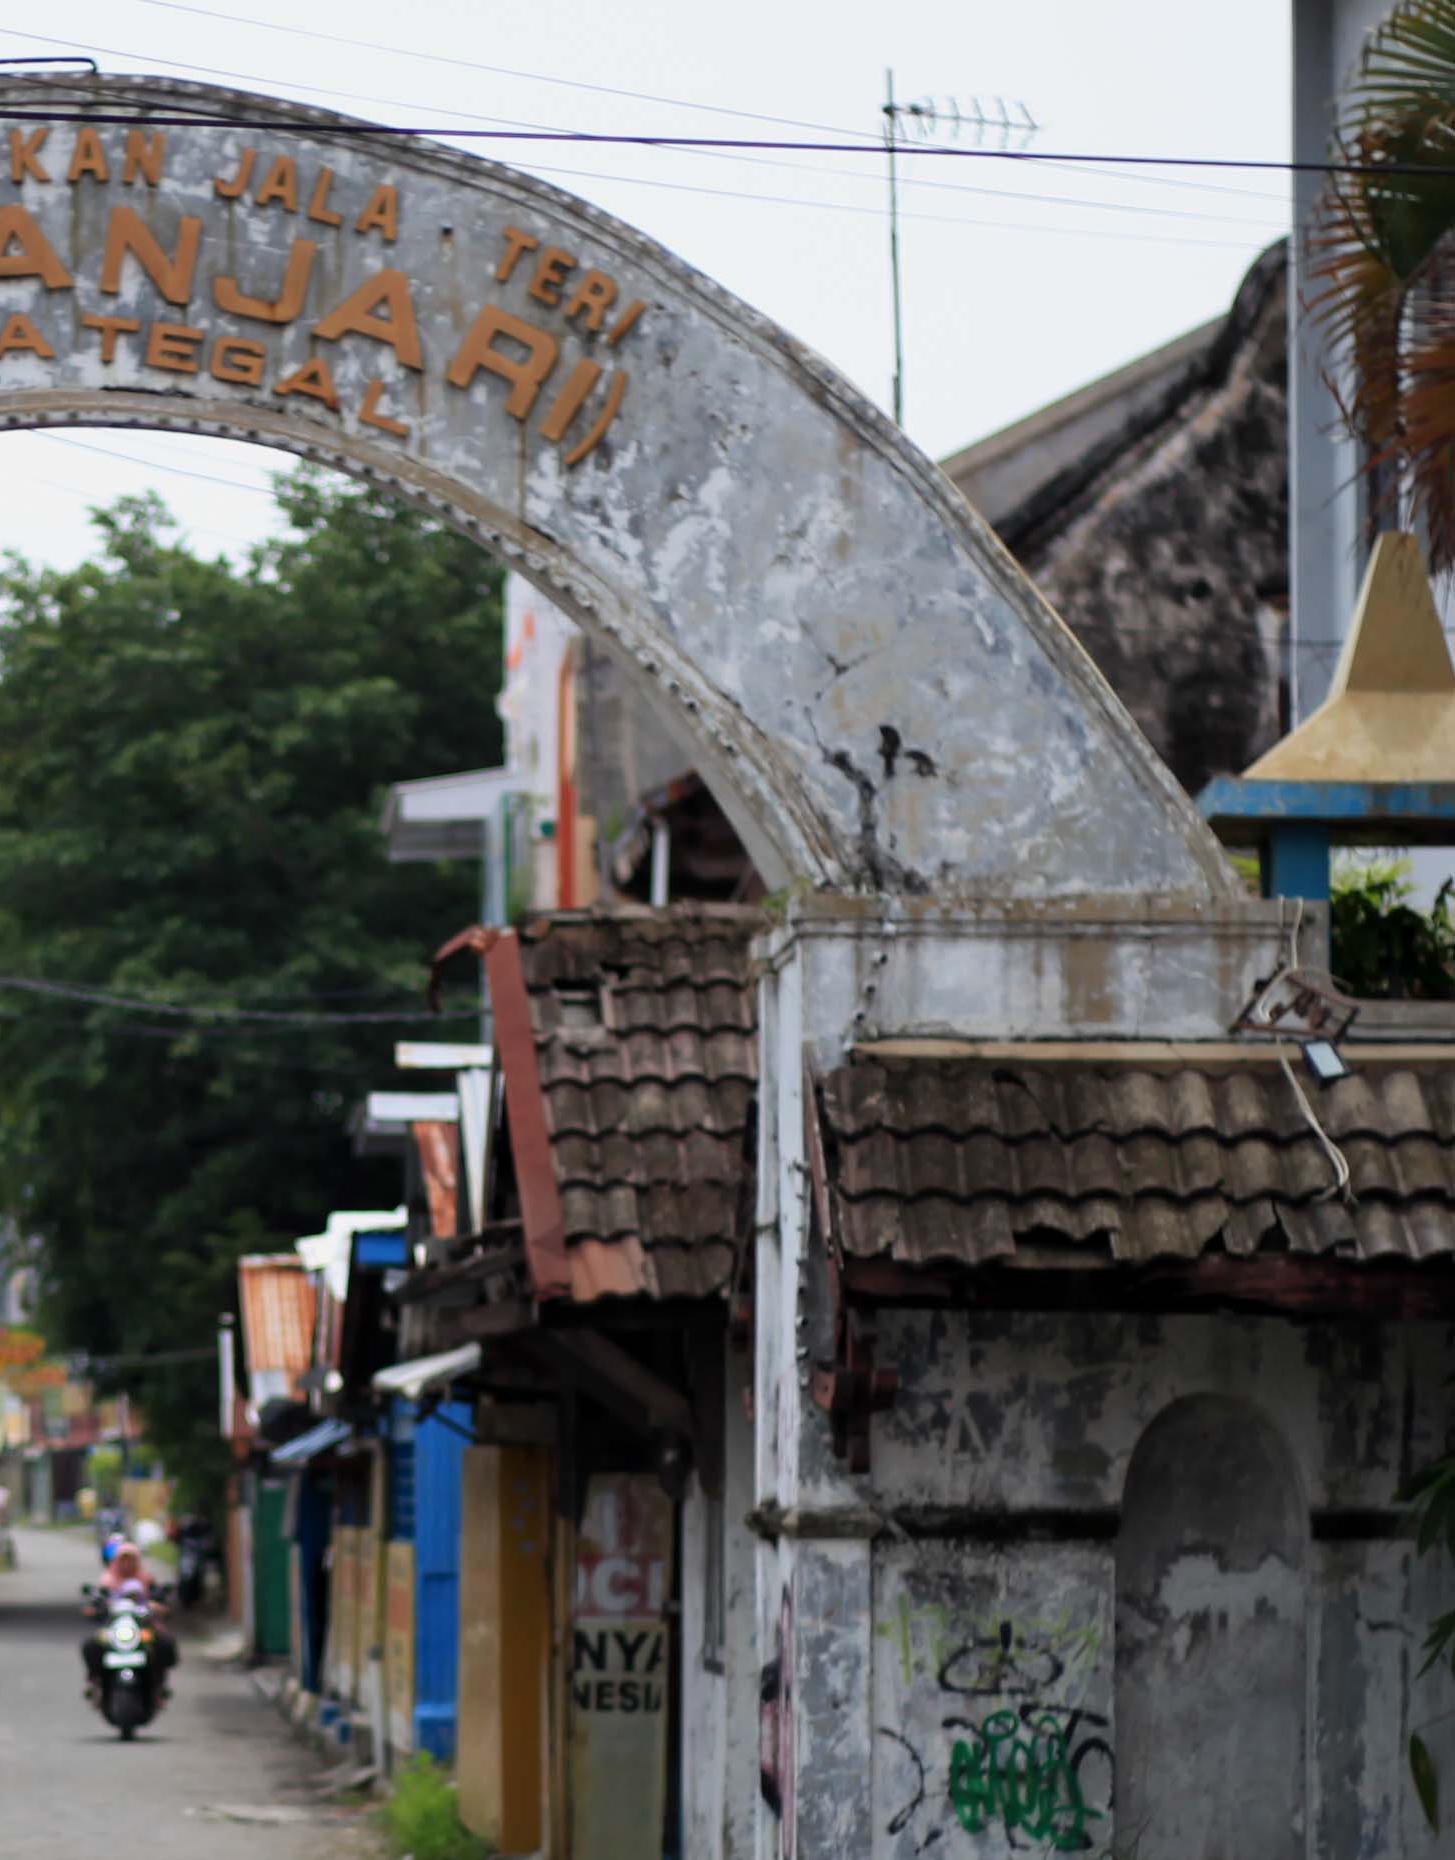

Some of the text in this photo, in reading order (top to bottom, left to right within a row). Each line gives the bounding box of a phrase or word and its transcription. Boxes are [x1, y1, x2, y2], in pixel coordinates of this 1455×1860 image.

[214, 147, 399, 242] JALA
[494, 225, 646, 347] TERI
[83, 314, 409, 437] TEGAL
